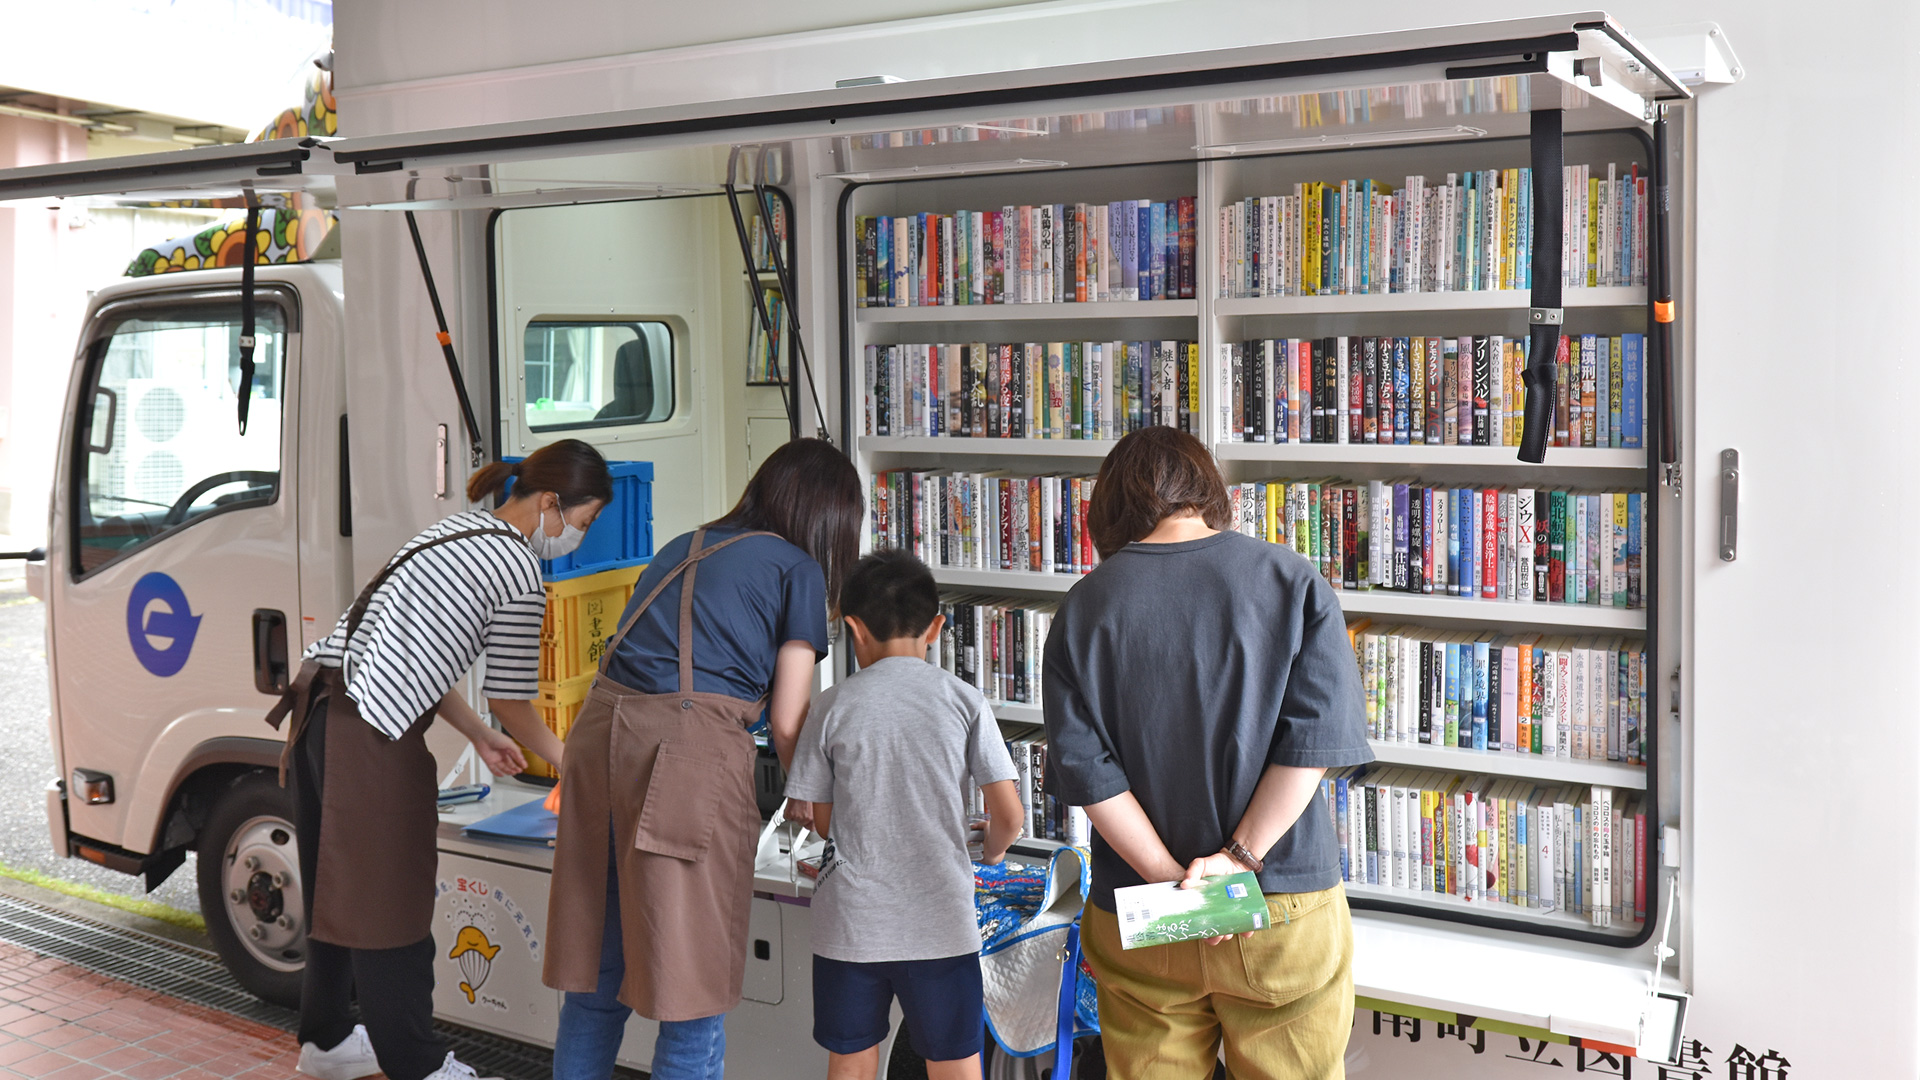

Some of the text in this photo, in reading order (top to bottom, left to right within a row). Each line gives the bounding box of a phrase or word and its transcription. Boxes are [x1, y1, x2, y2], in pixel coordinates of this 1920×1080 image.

[1003, 208, 1012, 249] 母の待つ里
[971, 347, 984, 407] 天下大乱
[1163, 350, 1174, 390] 継ぐ者
[1326, 356, 1336, 387] 化物園
[1381, 340, 1392, 398] 小さき王たち
[1395, 340, 1406, 398] 小さき王たち
[1411, 340, 1422, 398] 小さき王たち
[1429, 341, 1437, 385] デモクラシー
[1461, 344, 1471, 379] 風の値段
[1475, 337, 1489, 398] プリンシパル
[1582, 337, 1595, 393] 越境刑事
[1612, 361, 1620, 410] 名探偵外来
[1584, 412, 1592, 440] 中山七里
[1000, 491, 1008, 539] ナイトシフト
[1242, 487, 1254, 524] 紙の梟
[1518, 496, 1532, 543] ジウX
[1395, 552, 1406, 587] 仕掛島
[1521, 557, 1529, 589] 誉田哲也
[587, 598, 606, 664] 図書館
[1476, 660, 1485, 701] 罪の境界
[1523, 648, 1531, 717] 合理的にあり得ない
[1575, 653, 1584, 714] 永遠と横道世之介
[1594, 655, 1603, 716] 永遠と横道世之介
[1032, 753, 1043, 804] 百鬼大乱
[1542, 846, 1549, 854] 4
[457, 878, 488, 895] 宝くじ
